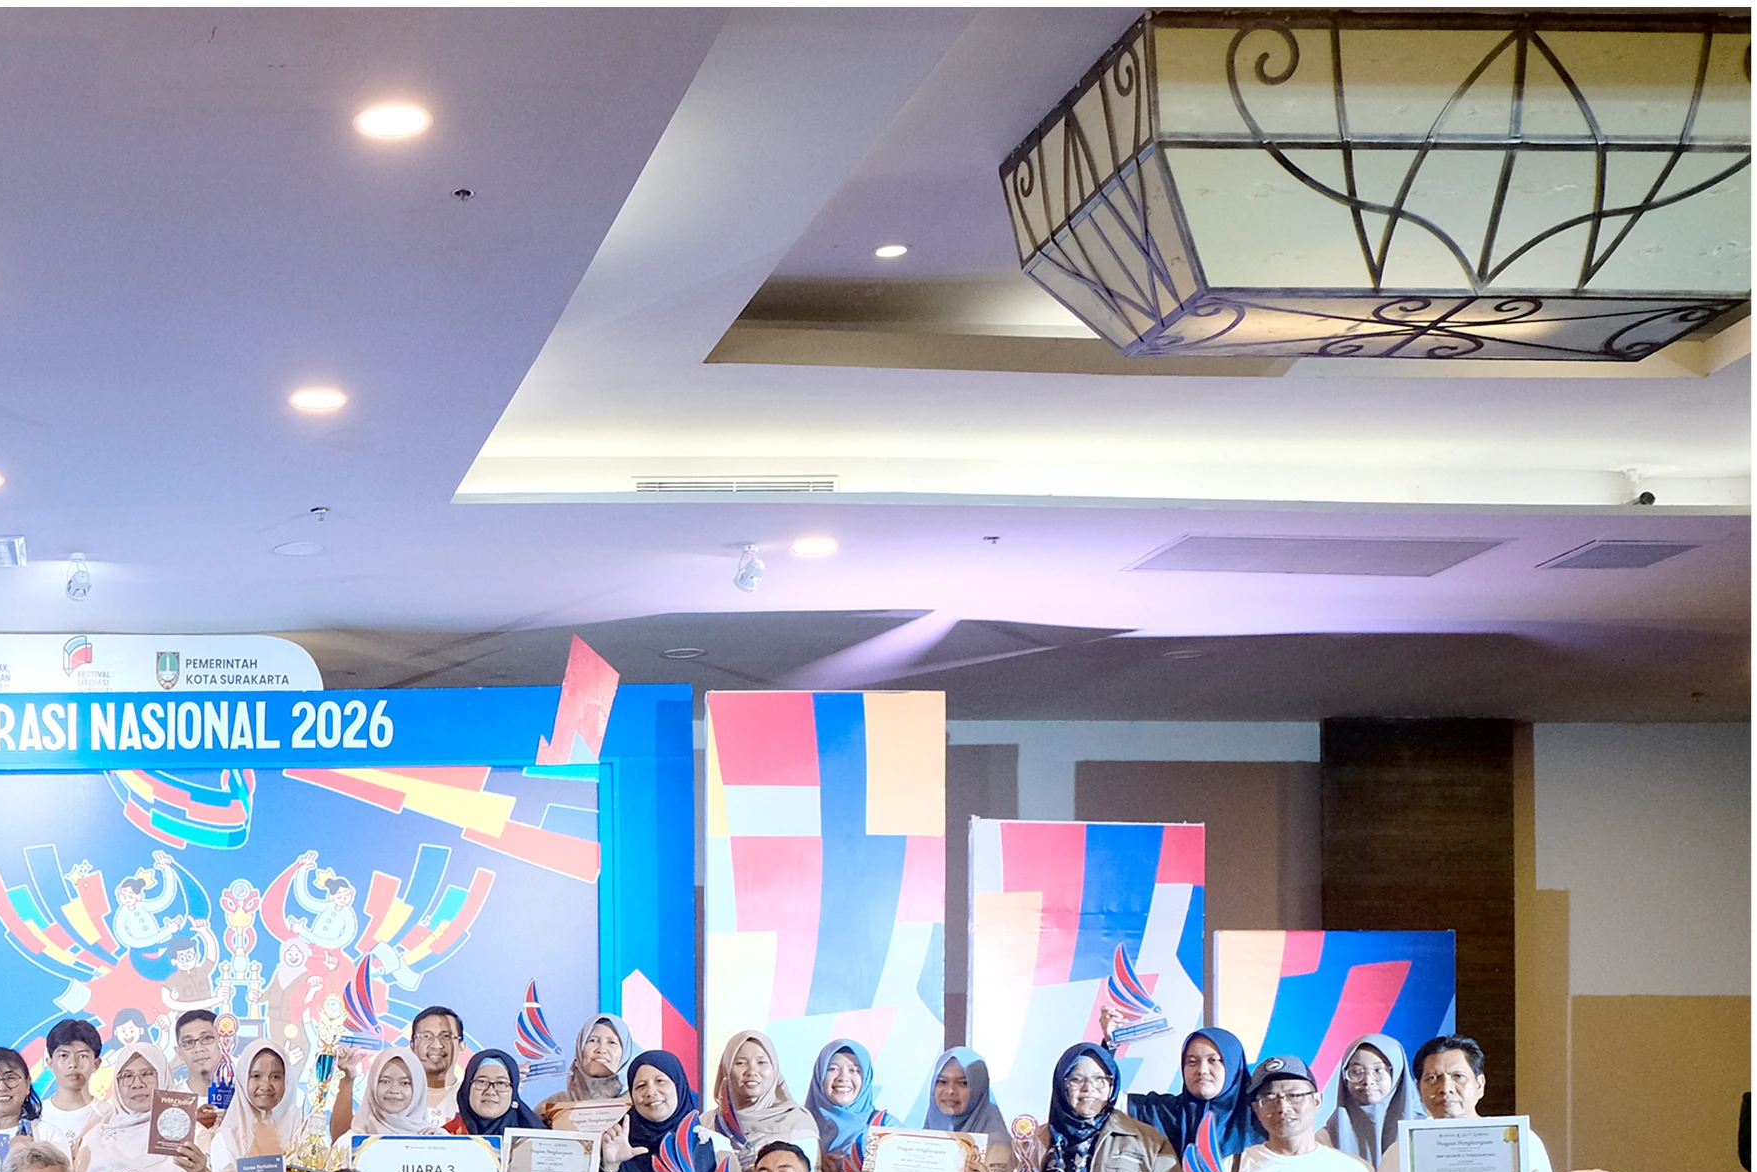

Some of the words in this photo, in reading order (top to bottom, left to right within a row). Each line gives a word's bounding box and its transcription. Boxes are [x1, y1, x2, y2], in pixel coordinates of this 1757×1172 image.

[186, 659, 258, 670] PEMERINTAH
[186, 674, 217, 685] KOTA
[220, 674, 290, 685] SURAKARTA
[92, 701, 280, 750] NASIONAL
[292, 700, 393, 749] 2026
[211, 1094, 222, 1102] 10
